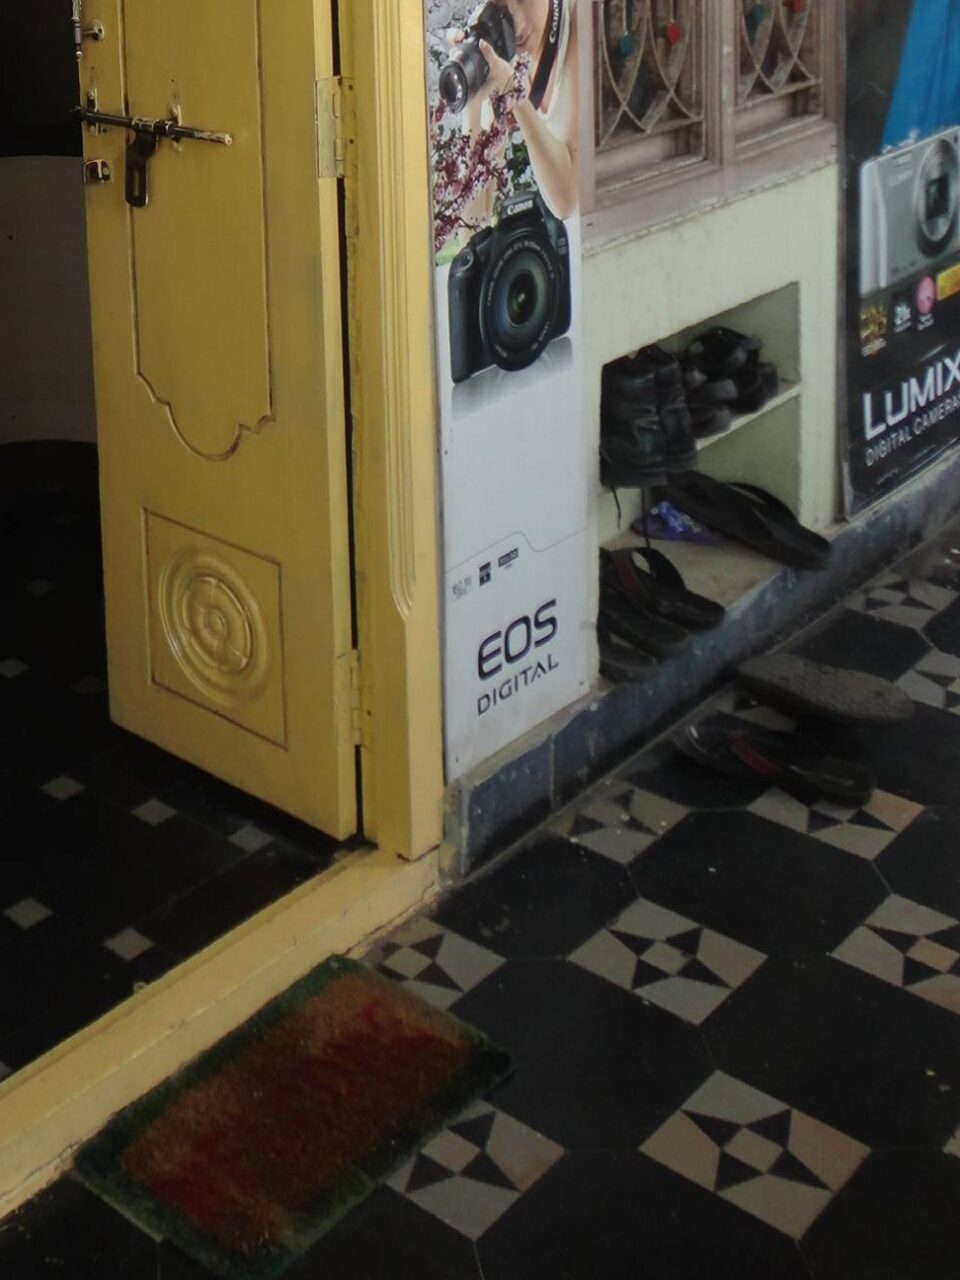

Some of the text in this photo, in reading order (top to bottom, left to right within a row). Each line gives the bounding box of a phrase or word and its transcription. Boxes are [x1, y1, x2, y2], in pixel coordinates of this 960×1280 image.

[507, 199, 534, 215] Canon
[863, 350, 960, 442] LUMIX
[865, 424, 912, 467] DIGITAL
[913, 392, 960, 437] CAMERA
[477, 599, 558, 682] EOS
[477, 653, 560, 717] DIGITAL
